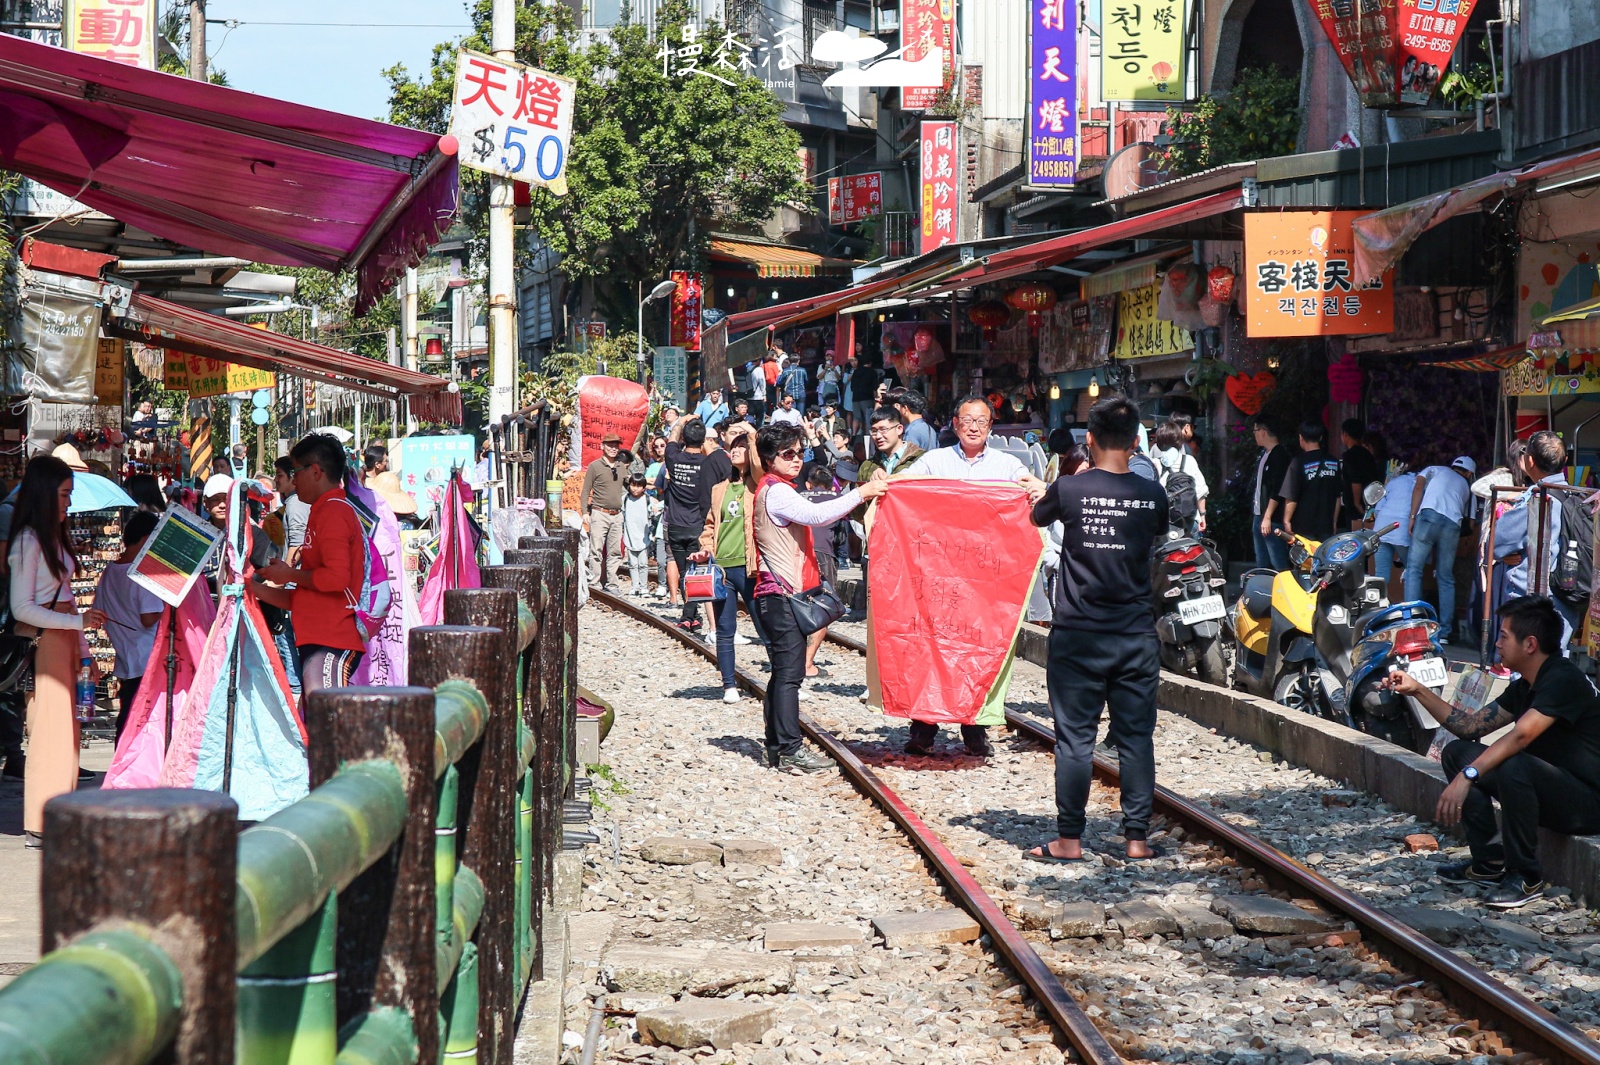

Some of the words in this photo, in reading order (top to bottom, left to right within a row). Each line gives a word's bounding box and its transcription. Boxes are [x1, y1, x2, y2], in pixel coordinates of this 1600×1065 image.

[1409, 13, 1457, 36] 訂位專線
[1108, 3, 1148, 74] 천등
[1404, 33, 1453, 52] 2495-8585
[461, 58, 562, 130] 天燈
[472, 123, 564, 181] $50
[1034, 136, 1074, 157] 十分街114號
[1034, 160, 1074, 178] 24958850
[1278, 296, 1363, 317] 객잔천등
[45, 324, 85, 337] 24227150
[1097, 509, 1128, 517] LANTERN
